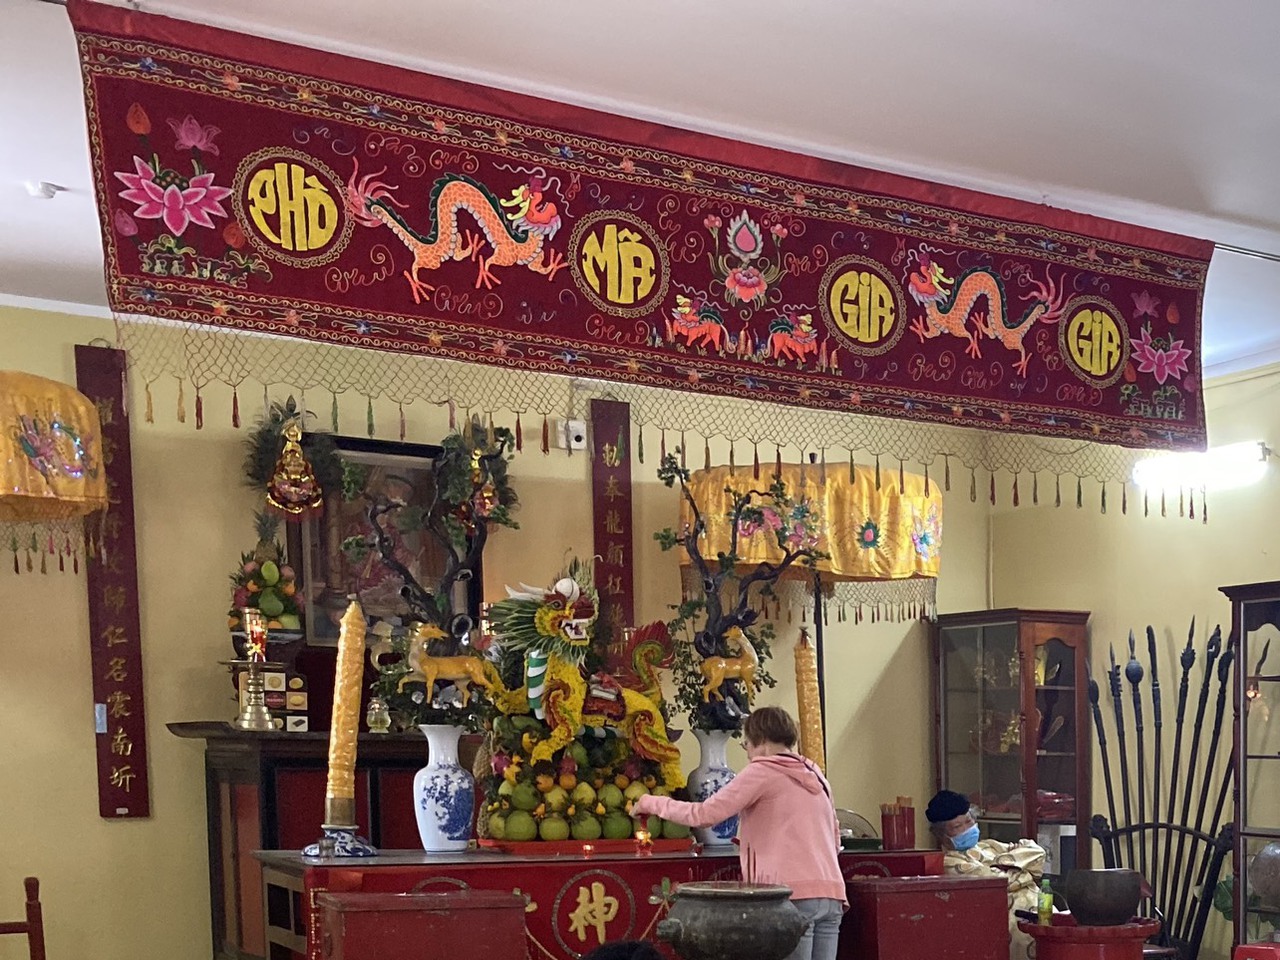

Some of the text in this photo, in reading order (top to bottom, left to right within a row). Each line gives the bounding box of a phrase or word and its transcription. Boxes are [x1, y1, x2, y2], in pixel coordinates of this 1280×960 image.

[248, 163, 338, 251] PHÒ
[582, 224, 656, 304] MÃ
[568, 882, 619, 945] 神
